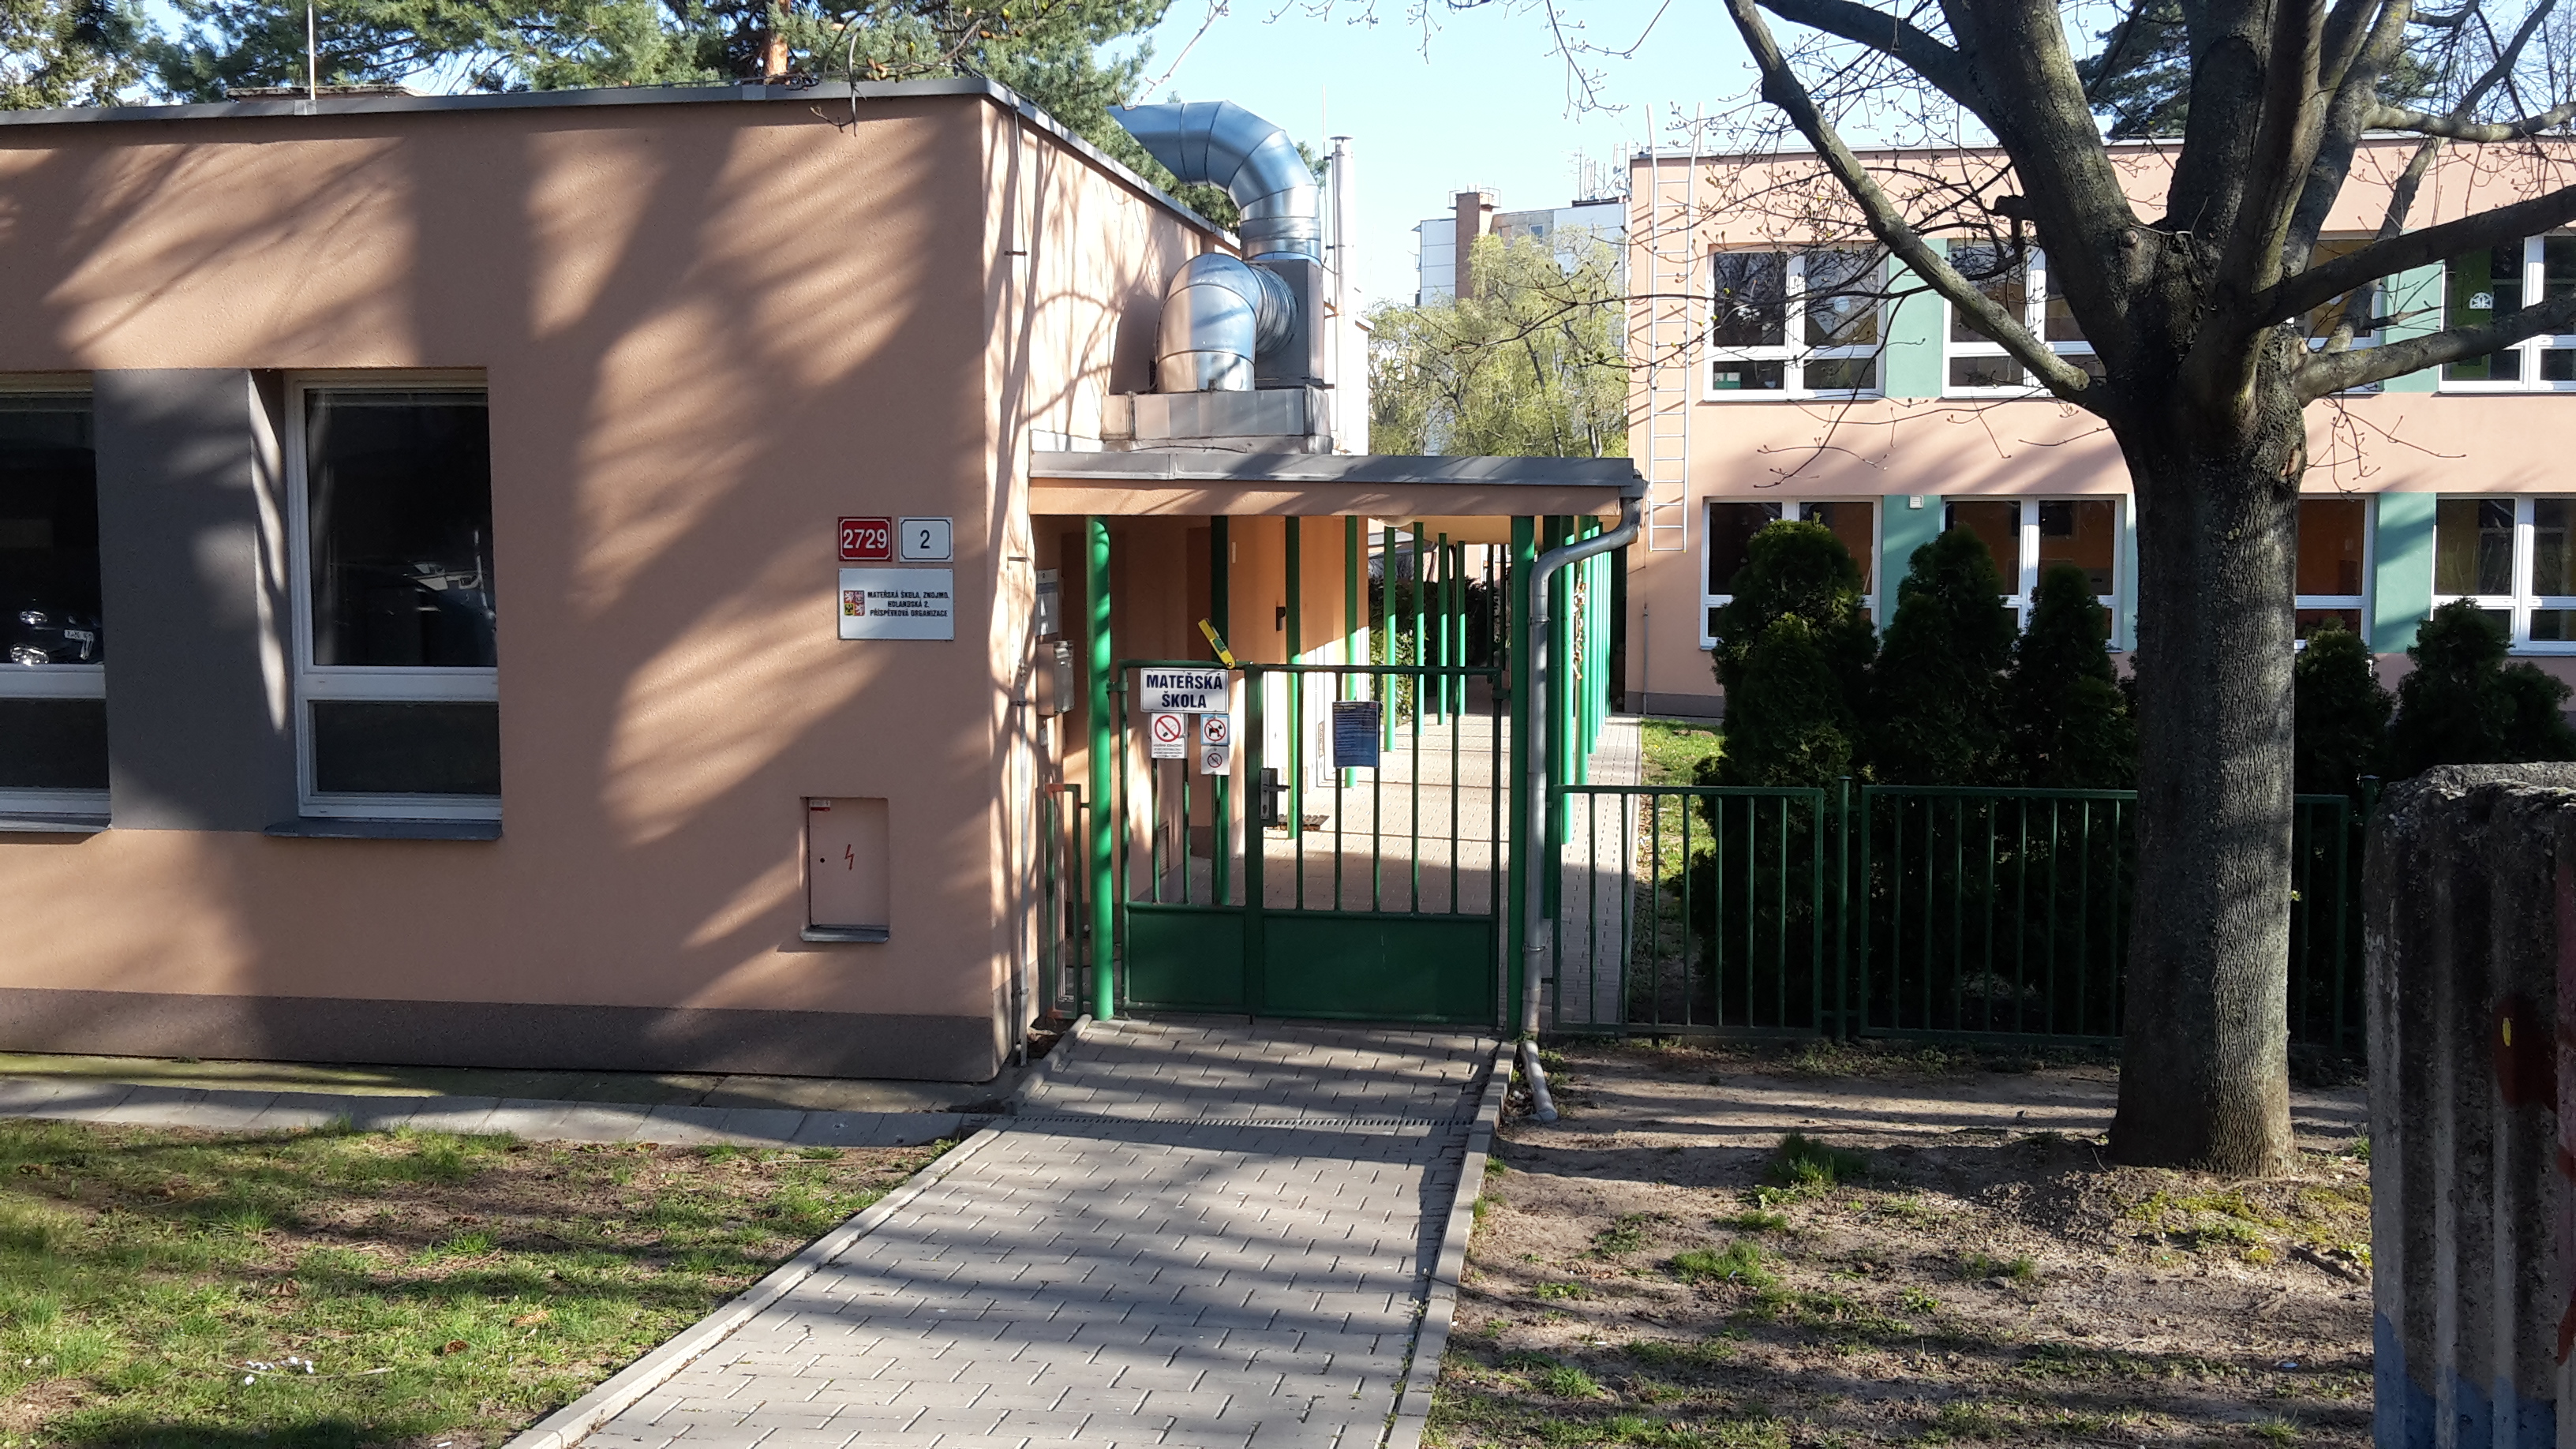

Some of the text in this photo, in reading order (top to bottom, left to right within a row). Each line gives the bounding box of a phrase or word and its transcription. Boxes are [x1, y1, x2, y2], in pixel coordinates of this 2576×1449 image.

[843, 529, 887, 549] 2729
[919, 530, 930, 549] 2
[1146, 672, 1222, 690] MATEŘSKÁ
[1161, 691, 1207, 708] ŠKOLA
